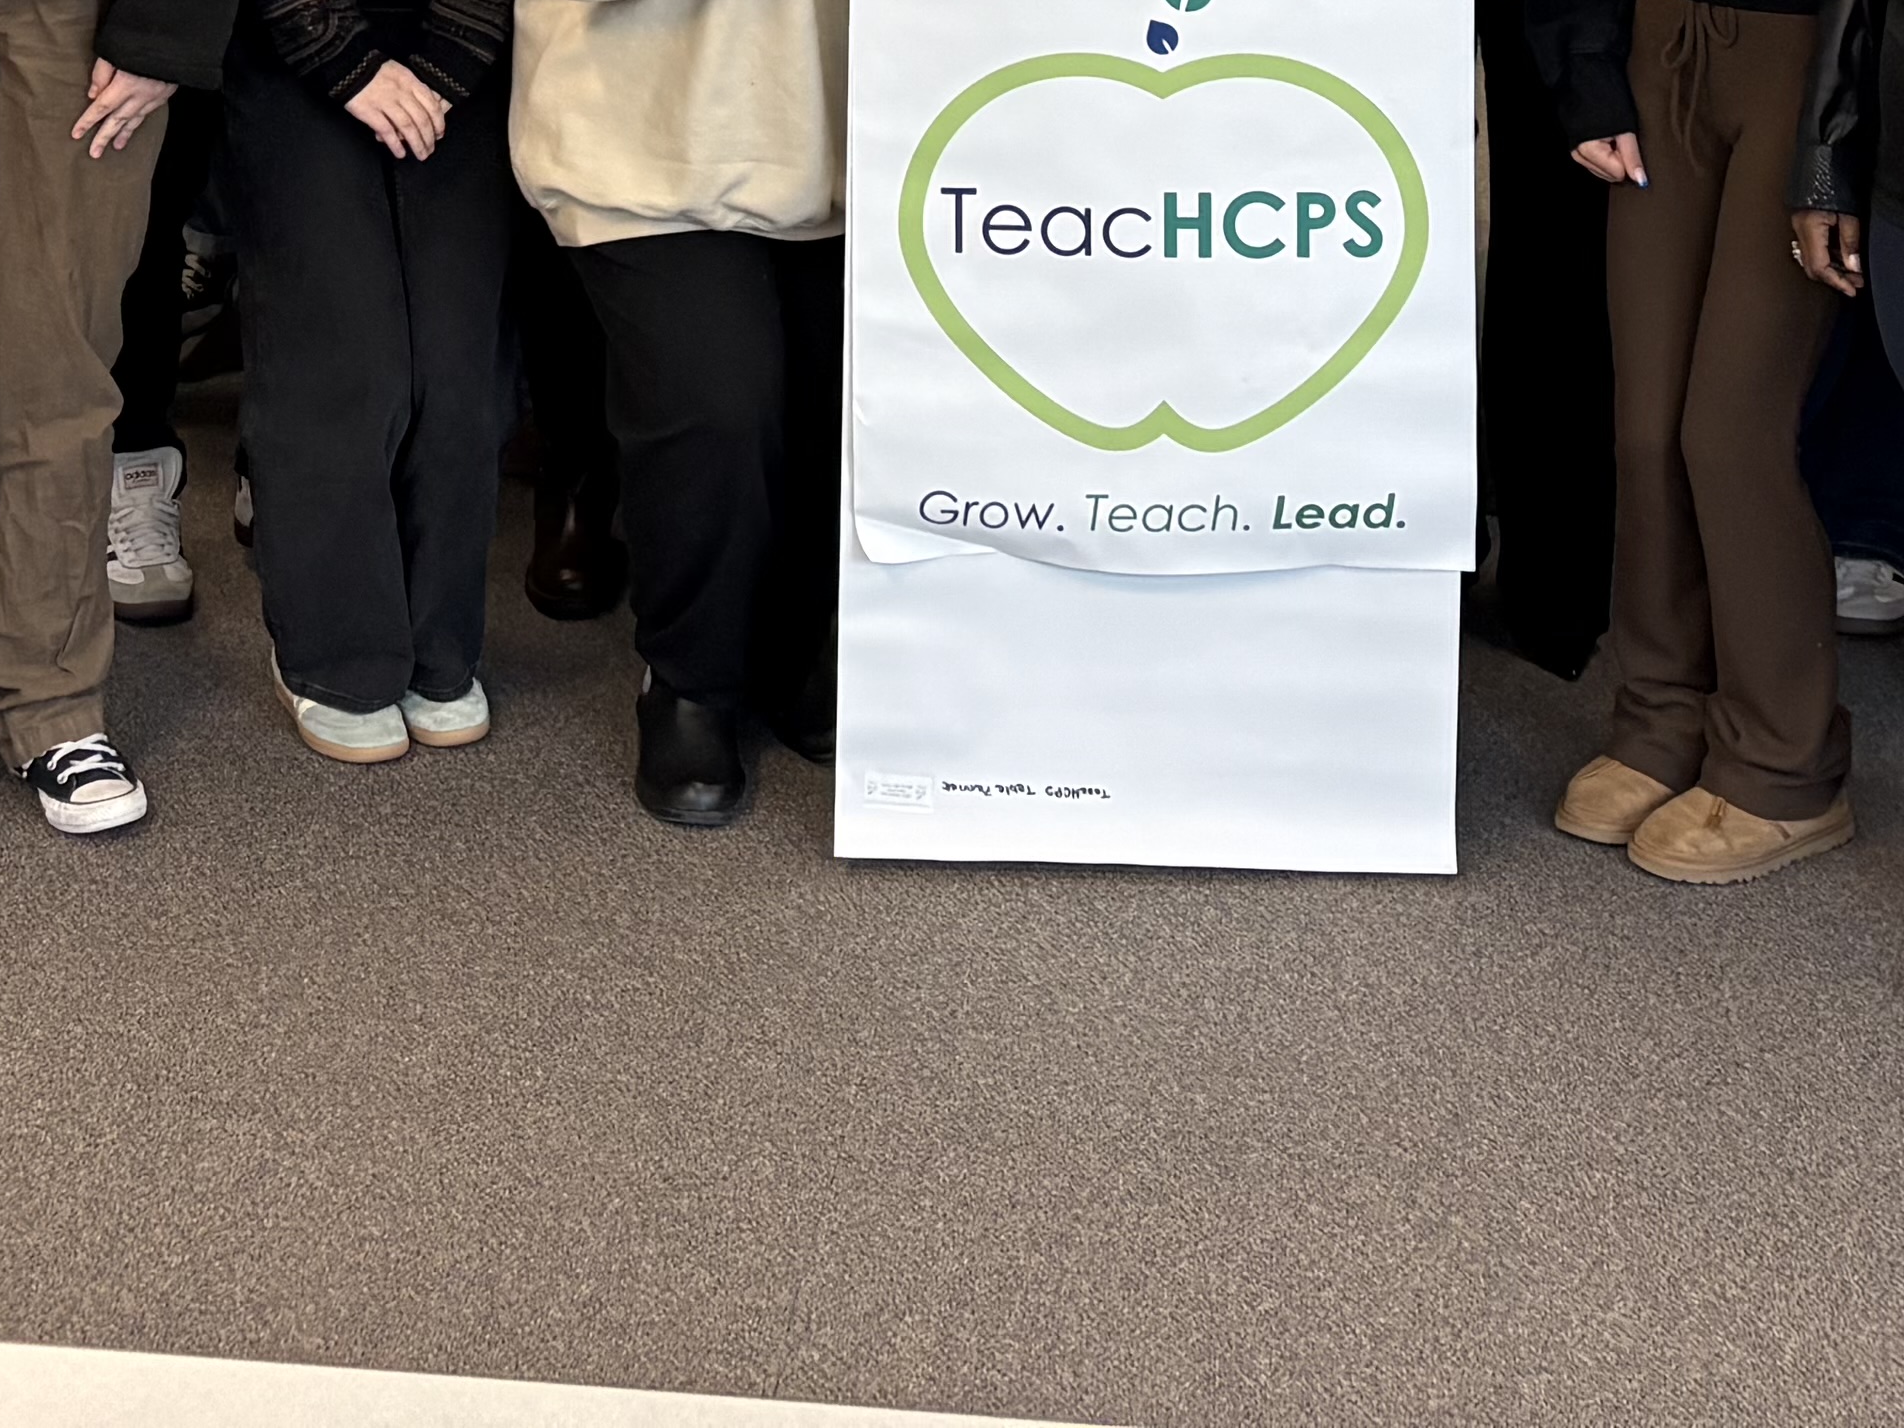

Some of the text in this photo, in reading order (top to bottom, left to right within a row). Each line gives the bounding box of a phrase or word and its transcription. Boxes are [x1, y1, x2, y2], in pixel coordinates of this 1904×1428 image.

[939, 187, 1384, 259] TeacHCPS
[919, 490, 1407, 533] Grow. Teach. Lead.
